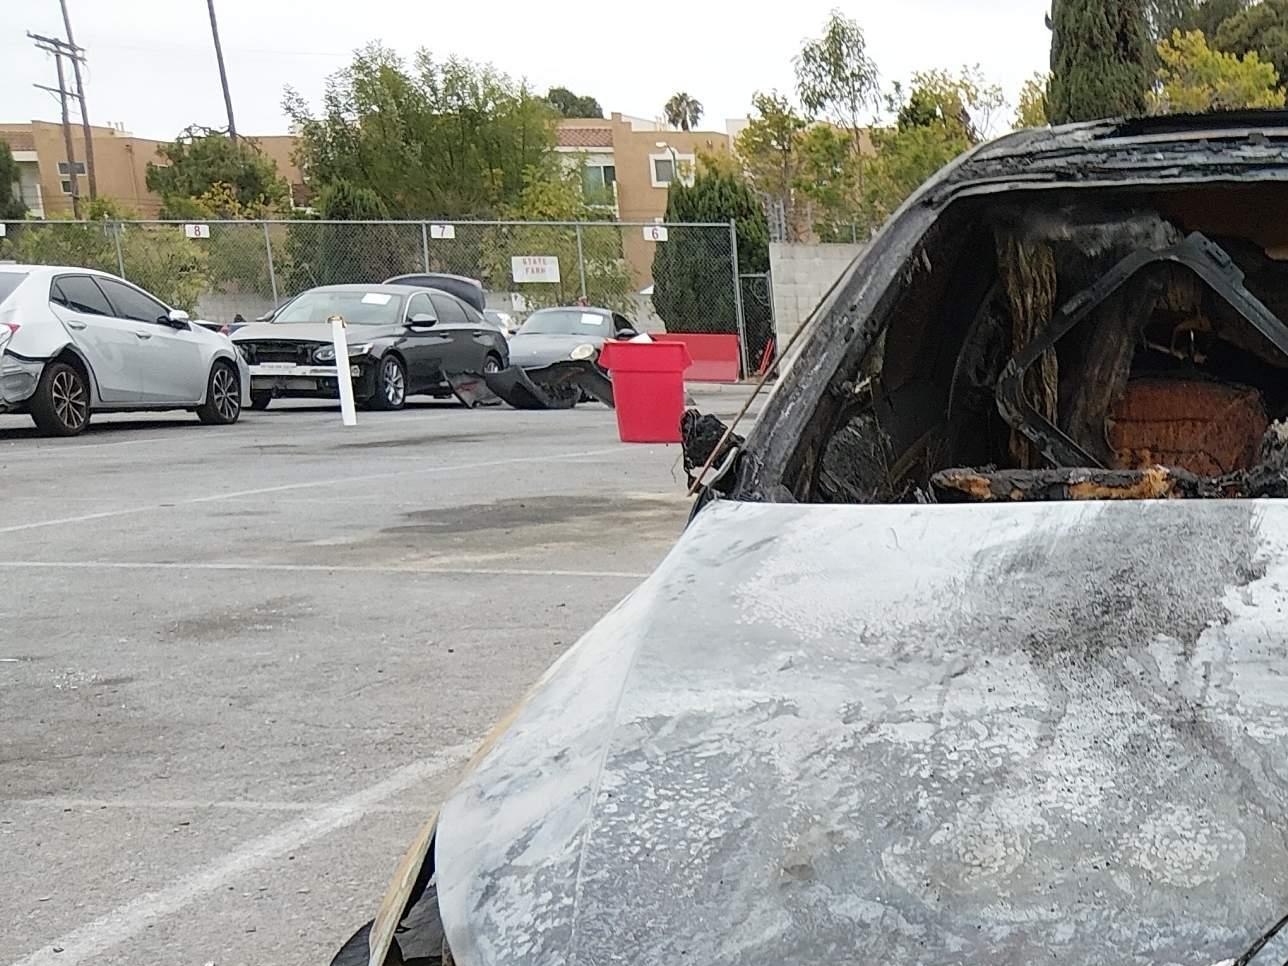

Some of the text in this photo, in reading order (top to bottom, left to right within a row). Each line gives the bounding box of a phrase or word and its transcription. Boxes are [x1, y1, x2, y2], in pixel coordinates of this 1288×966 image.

[194, 225, 201, 236] 8
[439, 225, 446, 238] 7
[651, 226, 659, 240] 6
